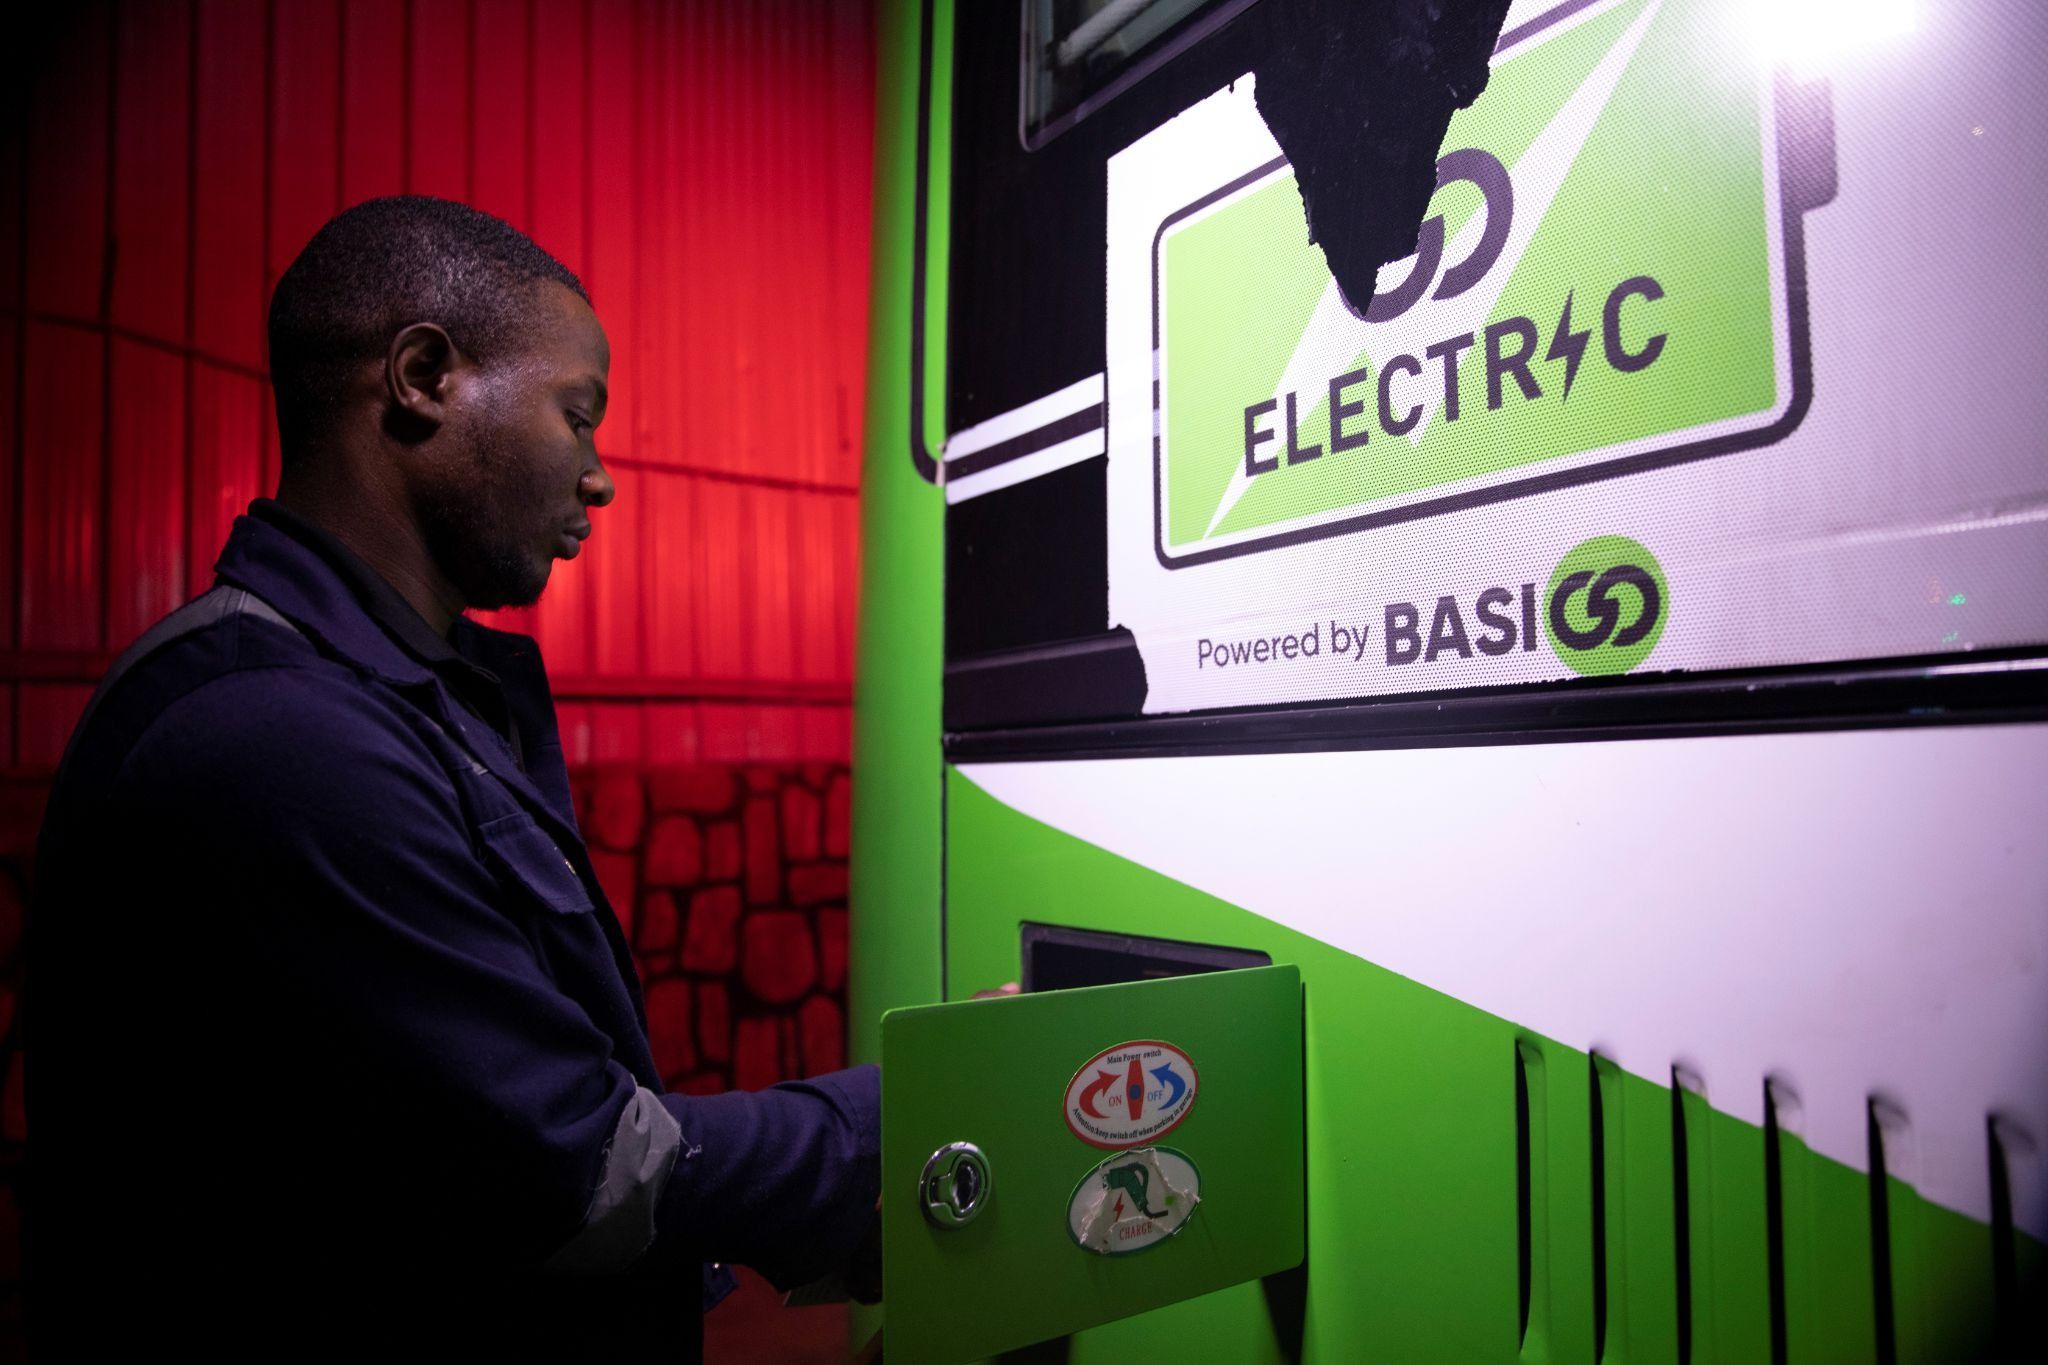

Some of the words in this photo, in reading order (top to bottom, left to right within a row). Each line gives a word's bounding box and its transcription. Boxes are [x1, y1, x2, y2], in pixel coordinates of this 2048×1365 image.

[1198, 621, 1320, 670] Powered
[1331, 619, 1370, 662] by
[1107, 1055, 1122, 1065] Main
[1123, 1053, 1141, 1063] Power
[1143, 1049, 1162, 1059] switch
[1109, 1095, 1122, 1107] ON
[1148, 1091, 1163, 1102] OFF
[1110, 1131, 1129, 1140] switch
[1129, 1130, 1138, 1139] off
[1138, 1127, 1154, 1137] when
[1154, 1113, 1175, 1133] parking
[1120, 1221, 1153, 1240] CHARGE
